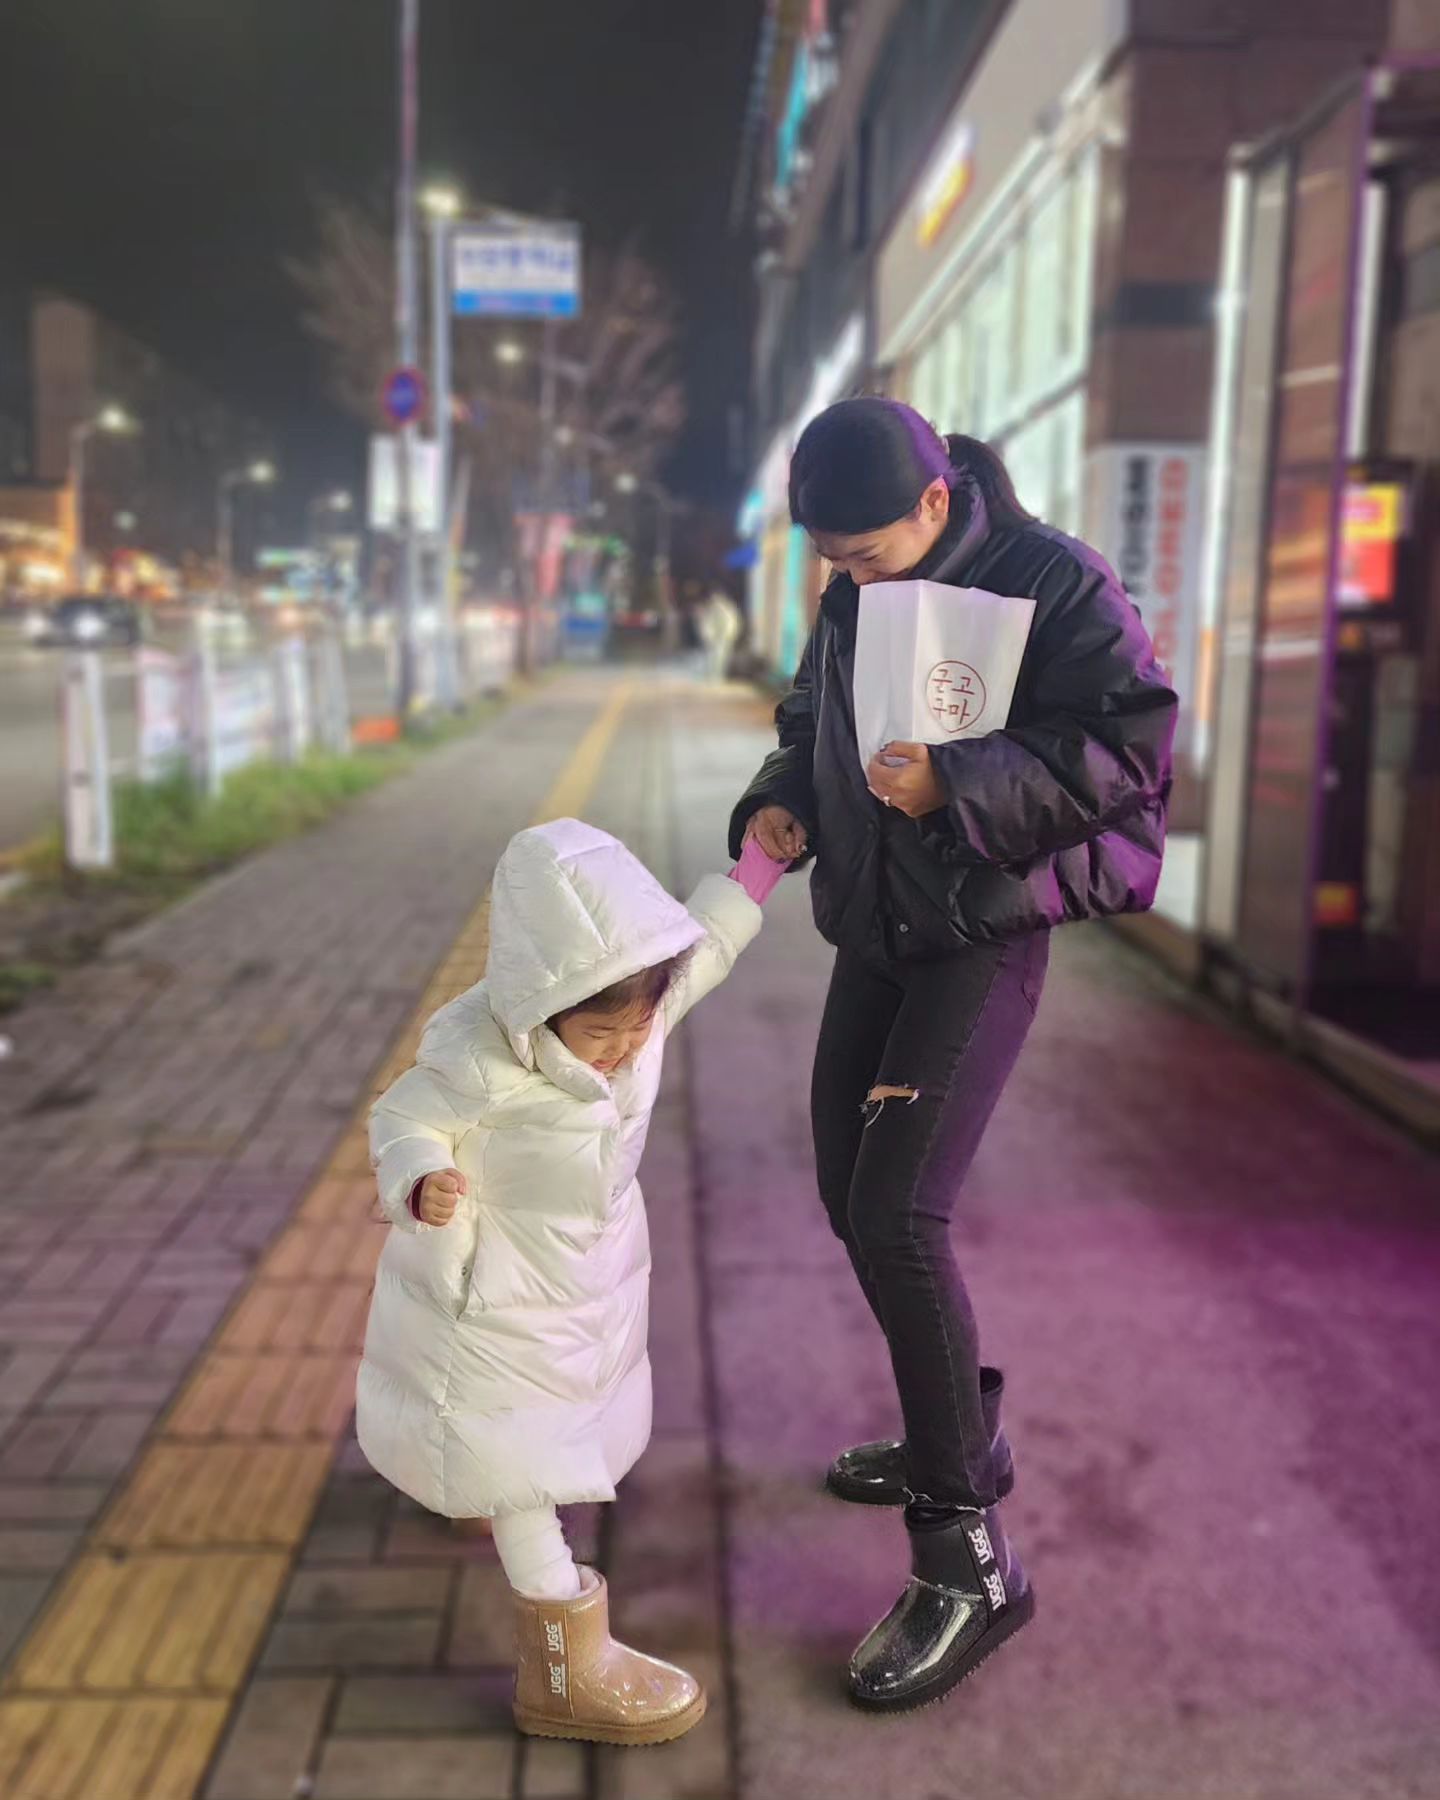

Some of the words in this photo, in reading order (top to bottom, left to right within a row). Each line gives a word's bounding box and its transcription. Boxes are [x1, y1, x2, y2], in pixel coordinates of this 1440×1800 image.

[932, 668, 975, 695] 군고
[933, 698, 970, 724] 구마
[970, 1527, 991, 1565] UGG
[985, 1573, 1003, 1611] UGG
[546, 1623, 561, 1652] UGG
[550, 1665, 562, 1694] UGG
